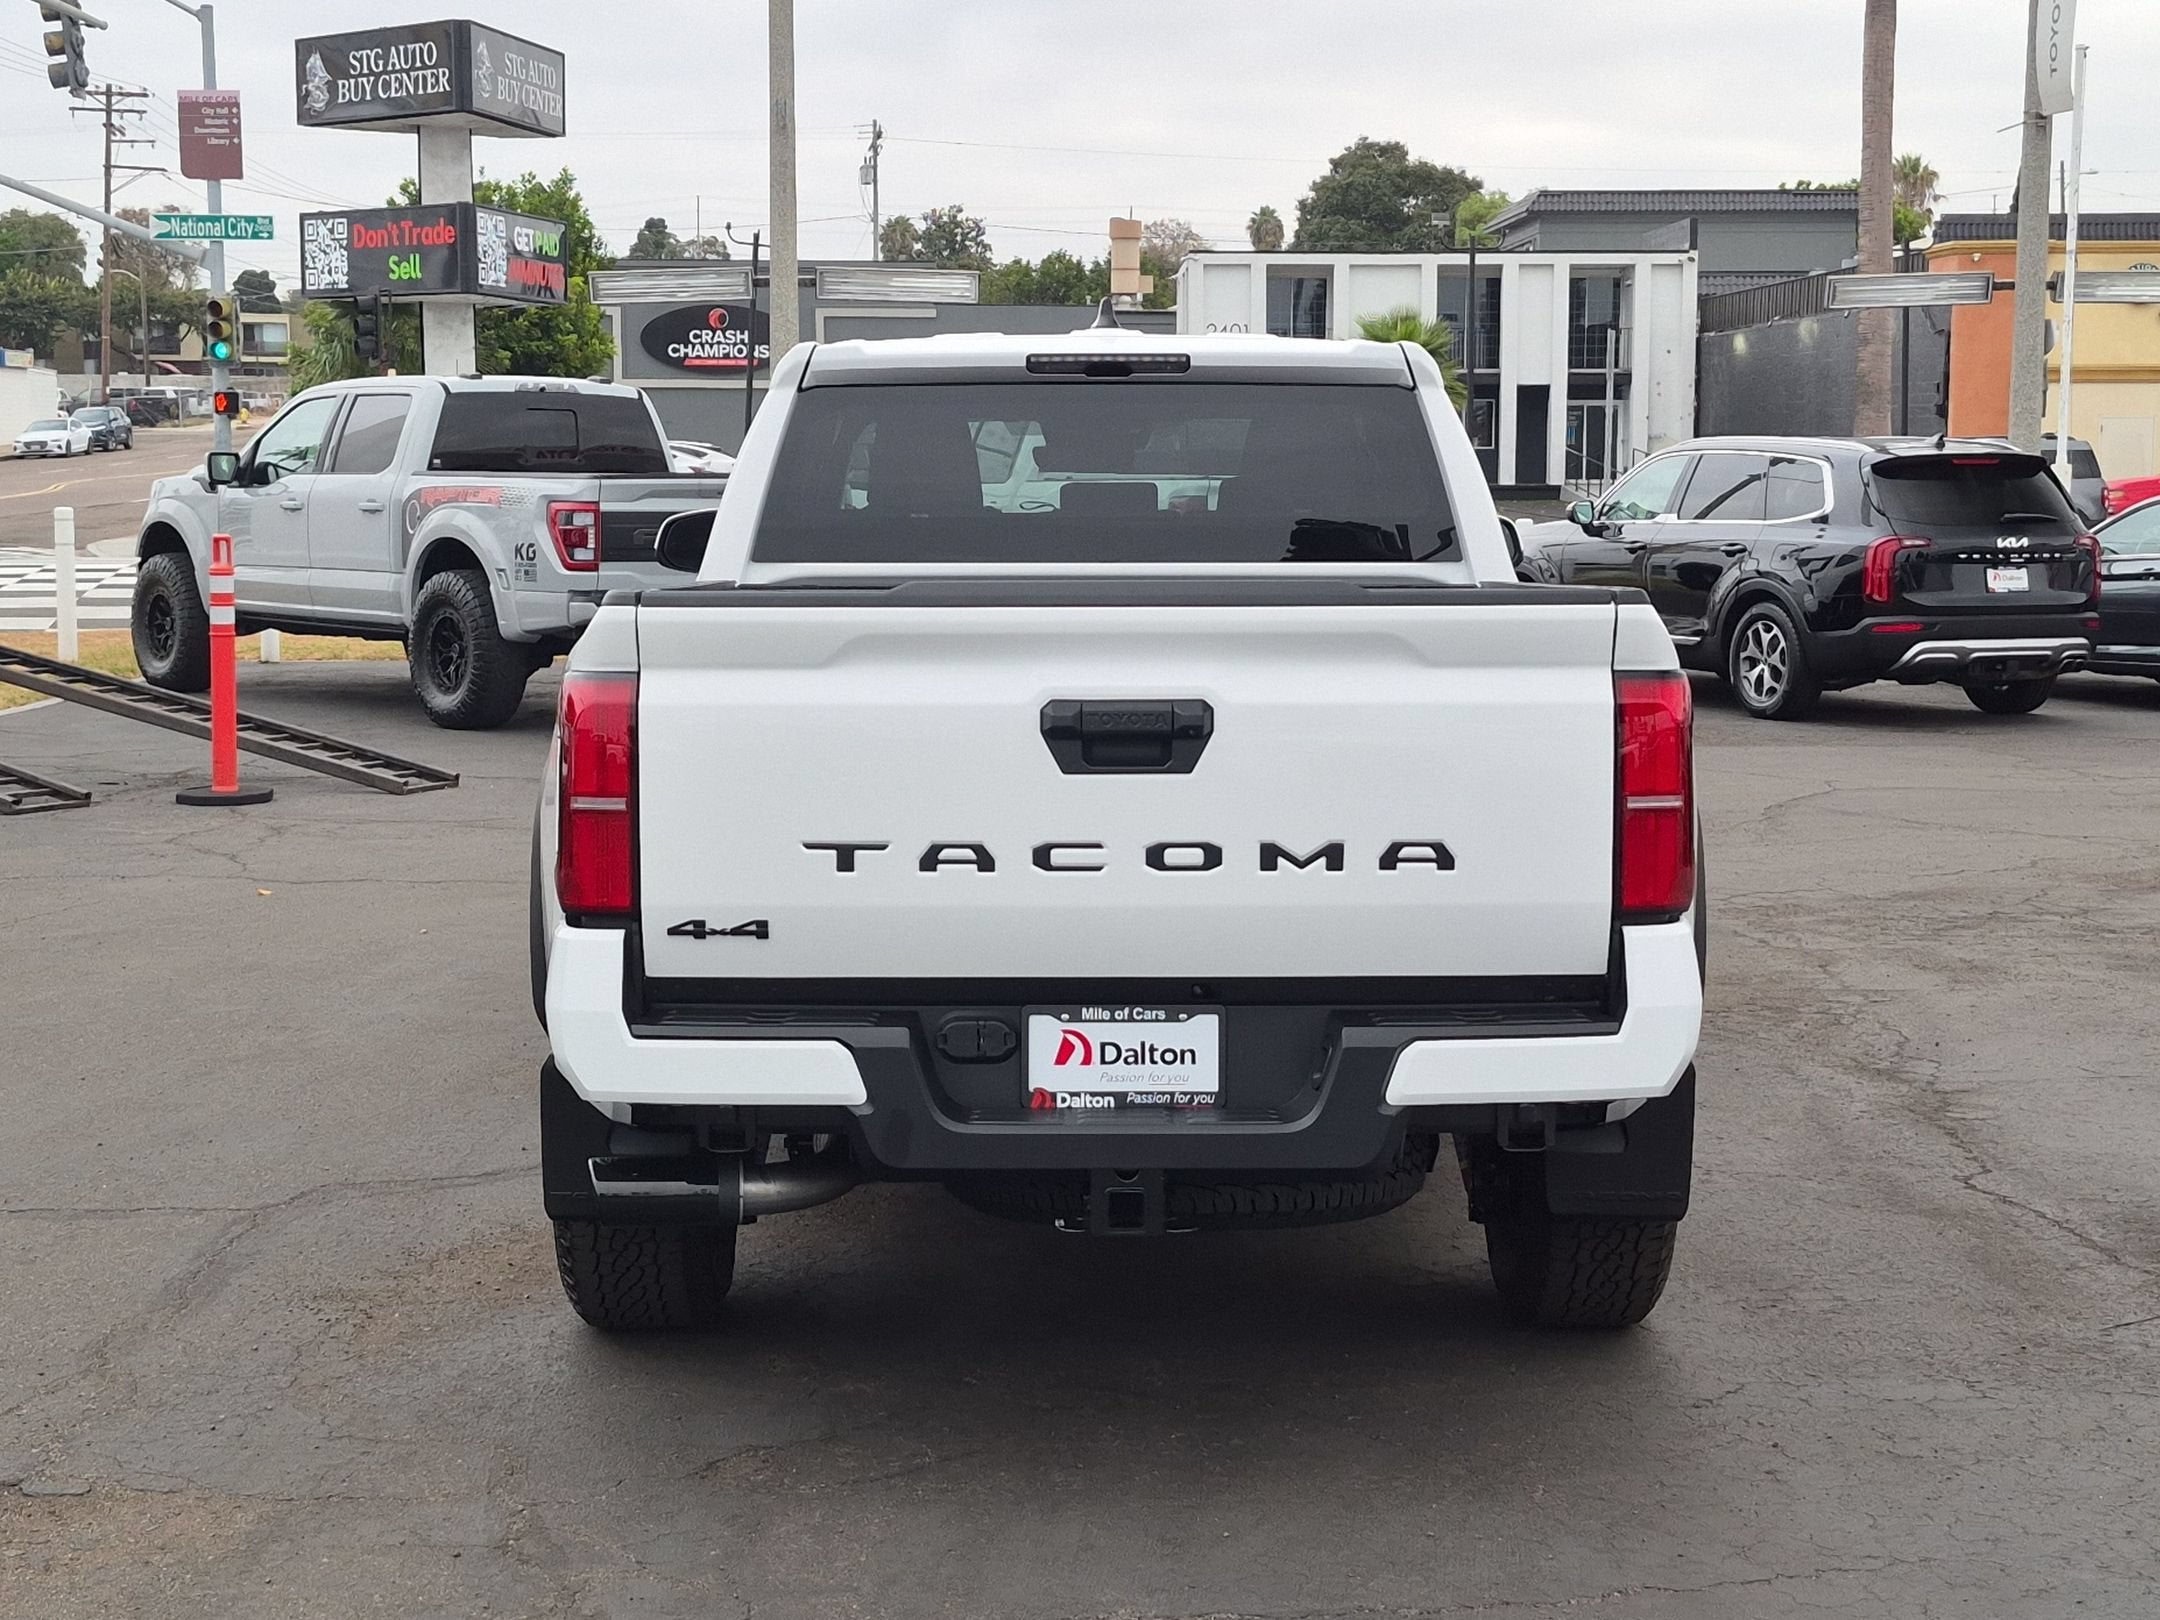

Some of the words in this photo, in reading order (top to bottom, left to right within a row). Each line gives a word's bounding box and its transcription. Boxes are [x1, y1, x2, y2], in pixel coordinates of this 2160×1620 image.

[2049, 0, 2061, 78] TOYO
[349, 48, 384, 75] STG
[387, 41, 437, 70] AUTO
[504, 52, 526, 79] STG
[528, 60, 556, 89] AUTO
[337, 77, 375, 104] BUY
[378, 68, 451, 99] CENTER
[497, 76, 521, 103] BUY
[522, 86, 562, 118] CENTER
[171, 217, 225, 237] National
[227, 217, 254, 238] City
[353, 221, 399, 248] Don't
[401, 217, 456, 245] Trade
[514, 226, 535, 253] GET
[535, 230, 560, 257] PAID
[388, 253, 422, 280] Sell
[689, 330, 749, 343] CRASH
[515, 543, 536, 561] KG
[1086, 712, 1168, 729] TOYOTA
[801, 839, 1457, 875] TACOMA
[1081, 1007, 1110, 1020] Mile
[1115, 1007, 1130, 1020] of
[1132, 1007, 1166, 1020] Cars
[1099, 1041, 1197, 1066] Dalton
[1100, 1071, 1144, 1083] Passion
[1147, 1071, 1165, 1083] for
[1166, 1074, 1190, 1084] you
[1056, 1093, 1115, 1108] Dalton
[1127, 1092, 1170, 1104] Passion
[1173, 1092, 1190, 1104] for
[1191, 1094, 1216, 1106] you
